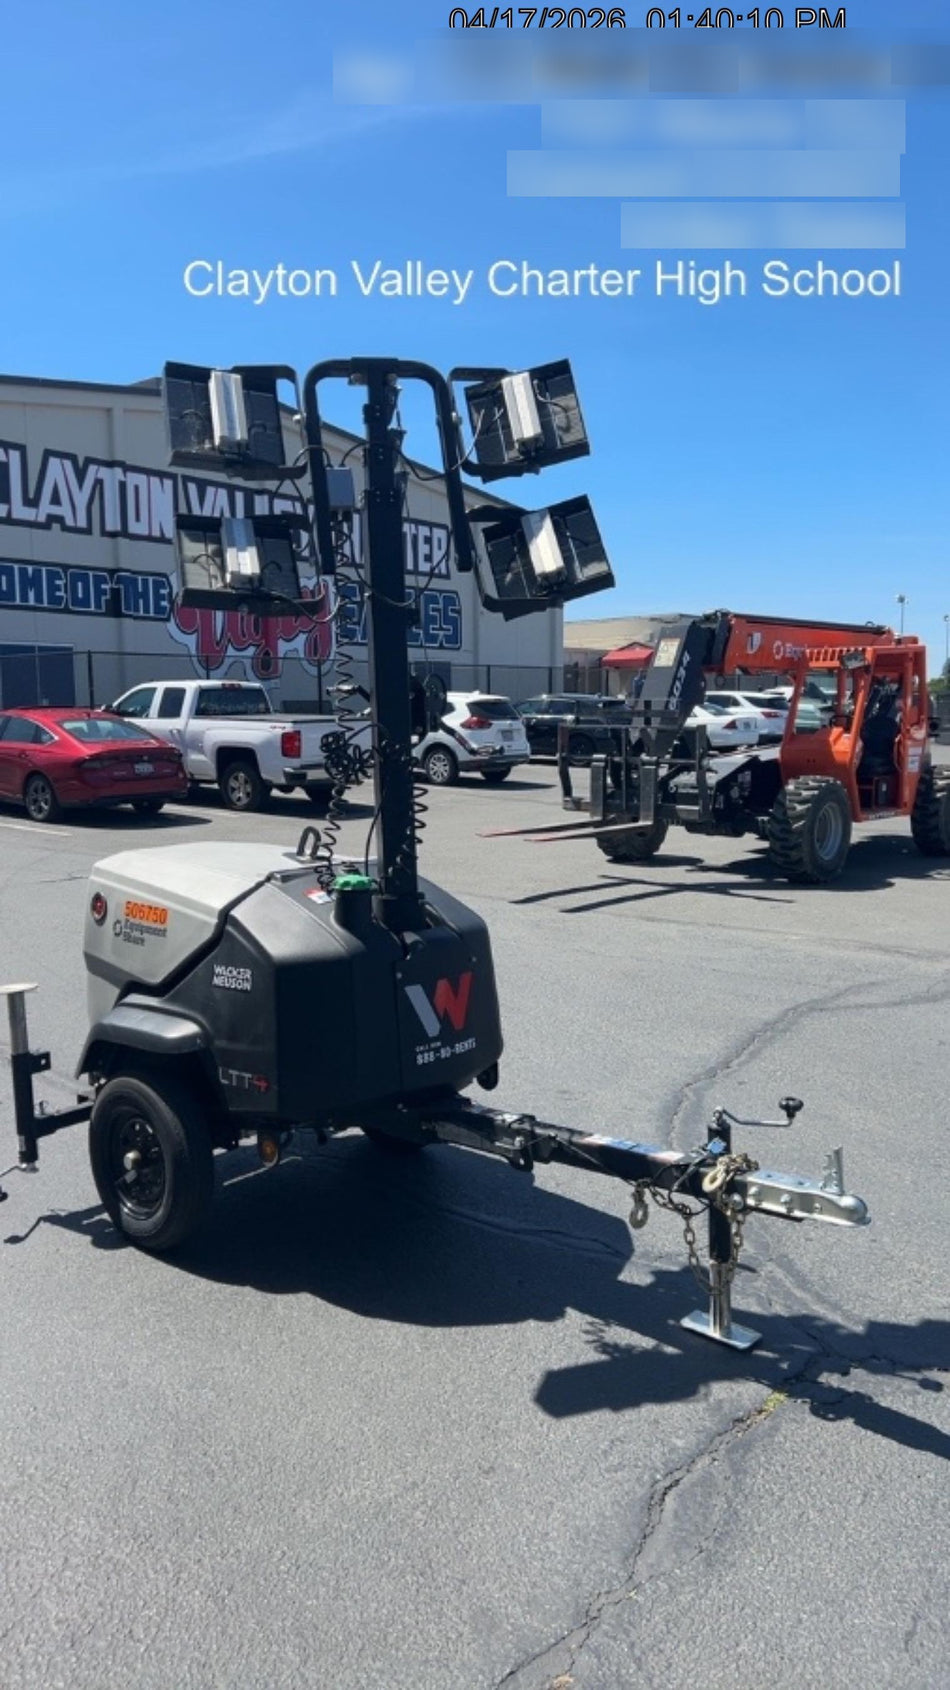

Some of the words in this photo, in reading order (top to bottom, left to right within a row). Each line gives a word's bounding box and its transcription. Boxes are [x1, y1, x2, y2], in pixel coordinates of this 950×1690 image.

[67, 568, 111, 613] OF
[113, 572, 171, 619] THE
[124, 899, 169, 925] 506750
[213, 964, 252, 980] WACKER
[212, 975, 252, 992] NEUSON
